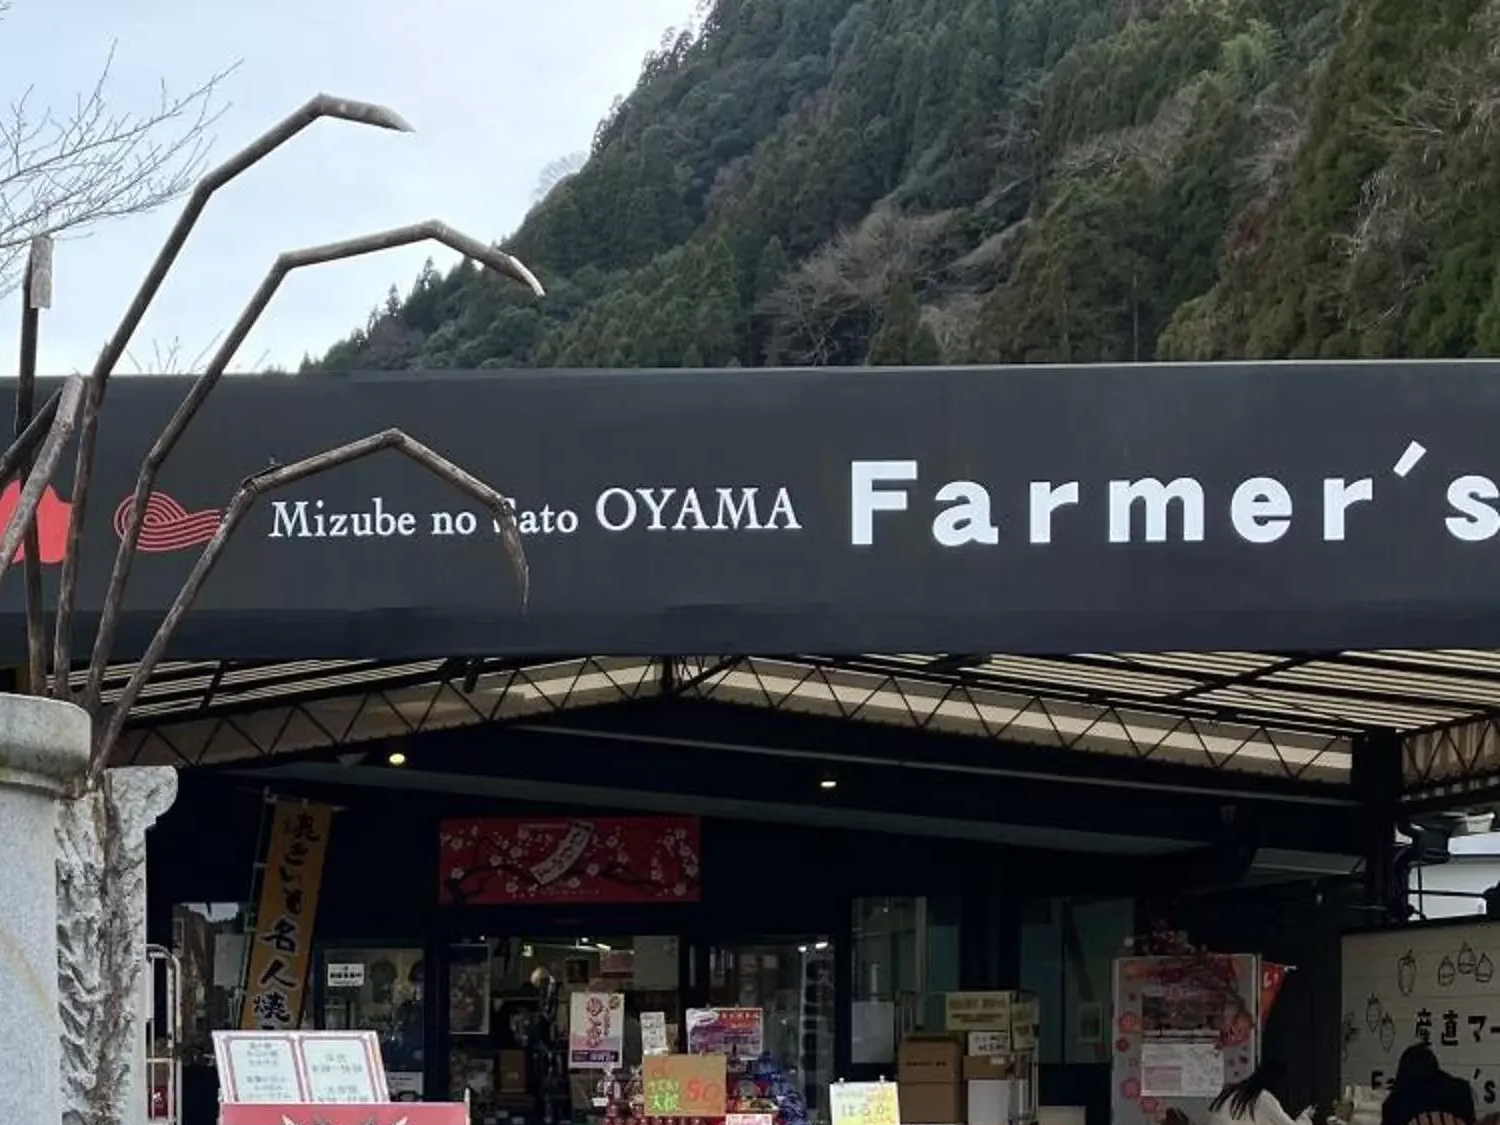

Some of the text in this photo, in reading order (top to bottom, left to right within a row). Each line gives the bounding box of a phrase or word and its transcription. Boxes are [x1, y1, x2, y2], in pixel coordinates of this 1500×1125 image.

[268, 498, 416, 538] Mizube
[430, 504, 478, 536] no
[597, 486, 803, 532] OYAMA
[850, 440, 1500, 547] Farmer's
